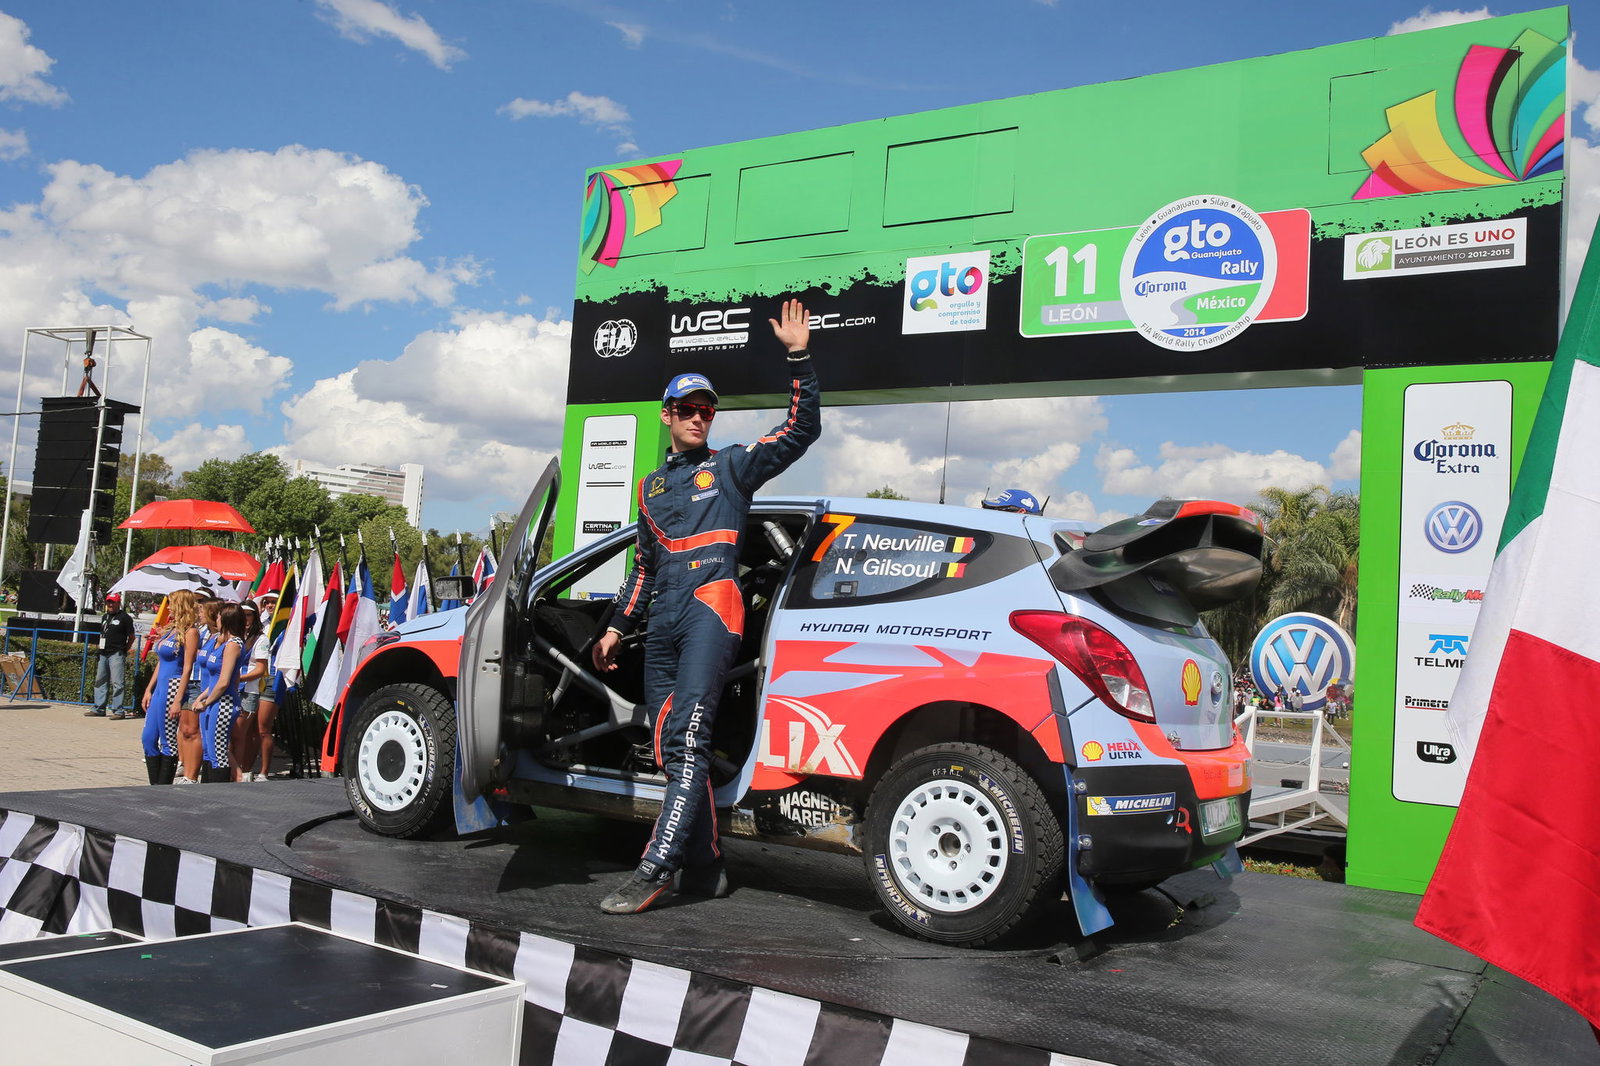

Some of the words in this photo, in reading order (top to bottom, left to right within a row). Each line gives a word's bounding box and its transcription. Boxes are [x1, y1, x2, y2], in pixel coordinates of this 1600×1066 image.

[1136, 225, 1152, 242] León
[1157, 200, 1200, 220] Guanajuato
[1210, 198, 1229, 208] Silao
[1236, 206, 1262, 230] Irapuato
[1164, 218, 1232, 262] gto
[1394, 234, 1441, 250] LEÓN
[1448, 232, 1469, 245] ES
[1474, 228, 1516, 243] UNO
[1191, 248, 1242, 260] Guanajuato
[1398, 252, 1466, 264] AYUNTAMIENTO
[1468, 249, 1510, 258] 2012-2015
[1045, 243, 1098, 297] 11
[1220, 260, 1259, 276] Rally
[910, 262, 982, 312] gto
[1134, 280, 1187, 298] Corona
[950, 301, 974, 309] orgullo
[1196, 296, 1246, 310] México
[671, 308, 751, 334] WRC
[938, 310, 980, 318] compromiso
[1048, 304, 1098, 322] LEÓN
[1140, 322, 1151, 334] FIA
[1152, 332, 1174, 345] World
[1174, 338, 1196, 348] Rally
[1198, 315, 1251, 346] Championship
[1184, 328, 1206, 336] 2014
[671, 344, 745, 353] CHAMPIONSHIP
[1414, 439, 1496, 463] Corona
[1436, 460, 1480, 474] Extra
[811, 514, 856, 562] 7
[843, 534, 858, 550] T.
[862, 534, 945, 552] Neuville
[700, 557, 725, 565] NEUVILLE
[834, 558, 856, 574] N.
[863, 559, 937, 578] Gilsoul
[800, 623, 870, 634] HYUNDAI
[876, 625, 992, 640] MOTORSPORT
[1107, 738, 1142, 752] HELIX
[1424, 744, 1450, 756] Ultra
[1109, 751, 1142, 760] ULTRA
[1115, 796, 1172, 810] MICHELIN
[990, 784, 1024, 852] MICHELIN
[655, 795, 686, 860] HYUNDAI
[876, 858, 916, 916] MICHELIN
